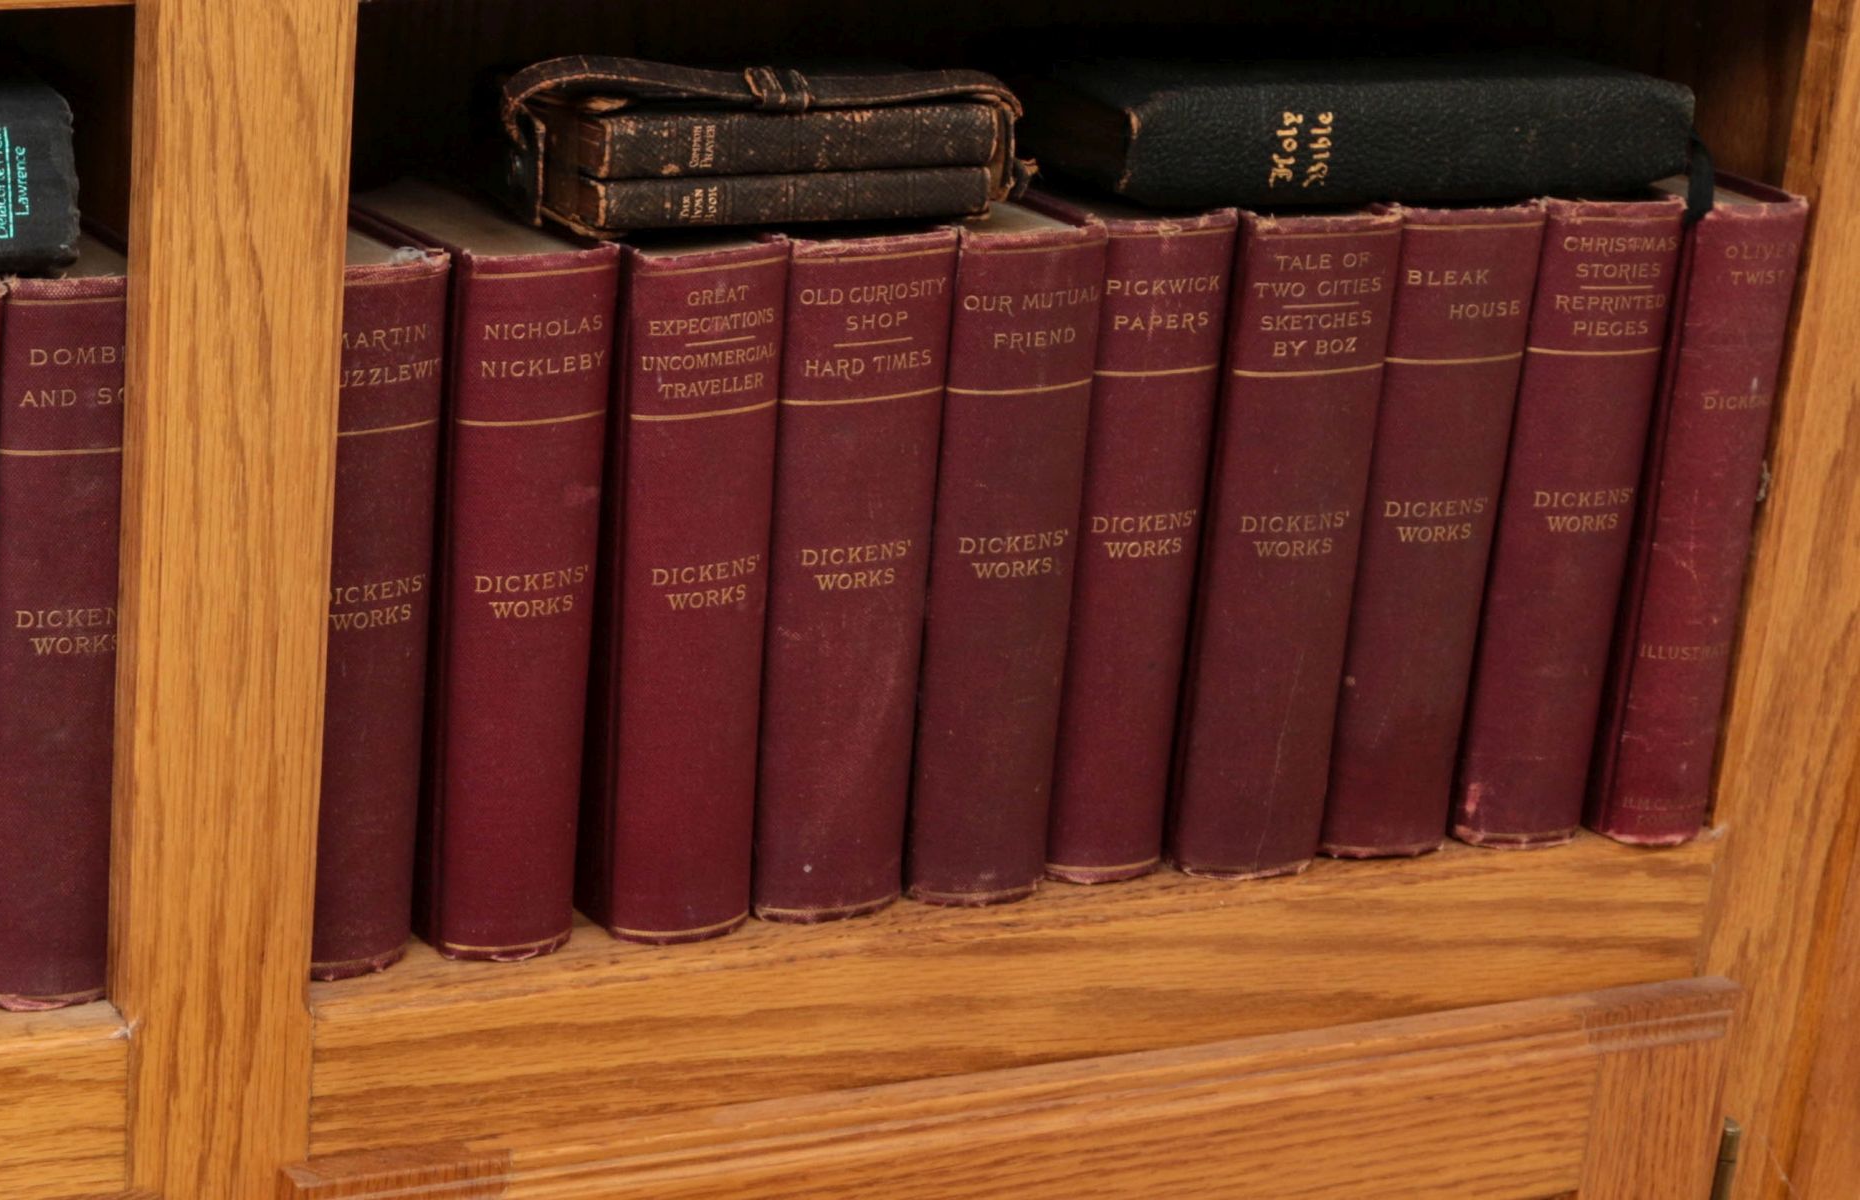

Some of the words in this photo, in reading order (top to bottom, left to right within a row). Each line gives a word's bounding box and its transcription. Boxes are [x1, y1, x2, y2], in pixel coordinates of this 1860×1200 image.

[1269, 112, 1303, 188] Holy
[1302, 111, 1334, 188] Bible
[14, 145, 30, 216] Lawrence
[1563, 236, 1677, 254] CHRISTMAS
[1276, 252, 1332, 272] TALE
[1343, 251, 1371, 268] OF
[1575, 262, 1662, 282] STORIES
[1105, 275, 1221, 297] PICKWICK
[1254, 281, 1307, 299] TWO
[1317, 276, 1382, 297] CITIES
[1406, 269, 1491, 287] BLEAK
[1730, 270, 1786, 286] TWIST
[687, 285, 749, 306] GREAT
[800, 287, 844, 306] OLD
[848, 277, 946, 307] CURIOSITY
[964, 295, 1015, 317] OUR
[1022, 286, 1099, 310] MUTUAL
[1554, 294, 1665, 313] REPRINTED
[649, 307, 774, 336] EXPECTATIONS
[846, 311, 909, 332] SHOP
[1113, 311, 1209, 333] PAPERS
[1260, 310, 1372, 332] SKETCHES
[1448, 301, 1521, 321] HOUSE
[483, 314, 603, 341] NICHOLAS
[1572, 320, 1650, 337] PIECES
[993, 327, 1076, 353] FRIEND
[1272, 340, 1308, 357] BY
[1315, 337, 1357, 355] BOZ
[29, 346, 125, 367] DOMB
[482, 350, 605, 378] NICKLEBY
[642, 343, 777, 371] UNCOMMERCIAL
[805, 357, 865, 382] HARD
[873, 349, 932, 374] TIMES
[19, 388, 77, 408] AND
[659, 373, 764, 400] TRAVELLER
[1383, 497, 1488, 519] DICKENS'
[1533, 487, 1635, 509] DICKENS'
[1091, 509, 1198, 535] DICKENS'
[1240, 510, 1349, 535] DICKENS'
[1396, 523, 1473, 544] WORKS
[1546, 512, 1620, 534] WORKS
[800, 540, 912, 567] DICKENS'
[958, 529, 1069, 555] DICKENS'
[1103, 536, 1184, 559] WORKS
[1252, 535, 1334, 559] WORKS
[474, 565, 589, 594] DICKENS'
[651, 554, 760, 587] DICKENS'
[814, 568, 896, 592] WORKS
[971, 557, 1054, 580] WORKS
[329, 573, 427, 605] ICKENS'
[664, 584, 747, 611] WORKS
[329, 604, 412, 631] WORKS
[489, 595, 574, 619] WORKS
